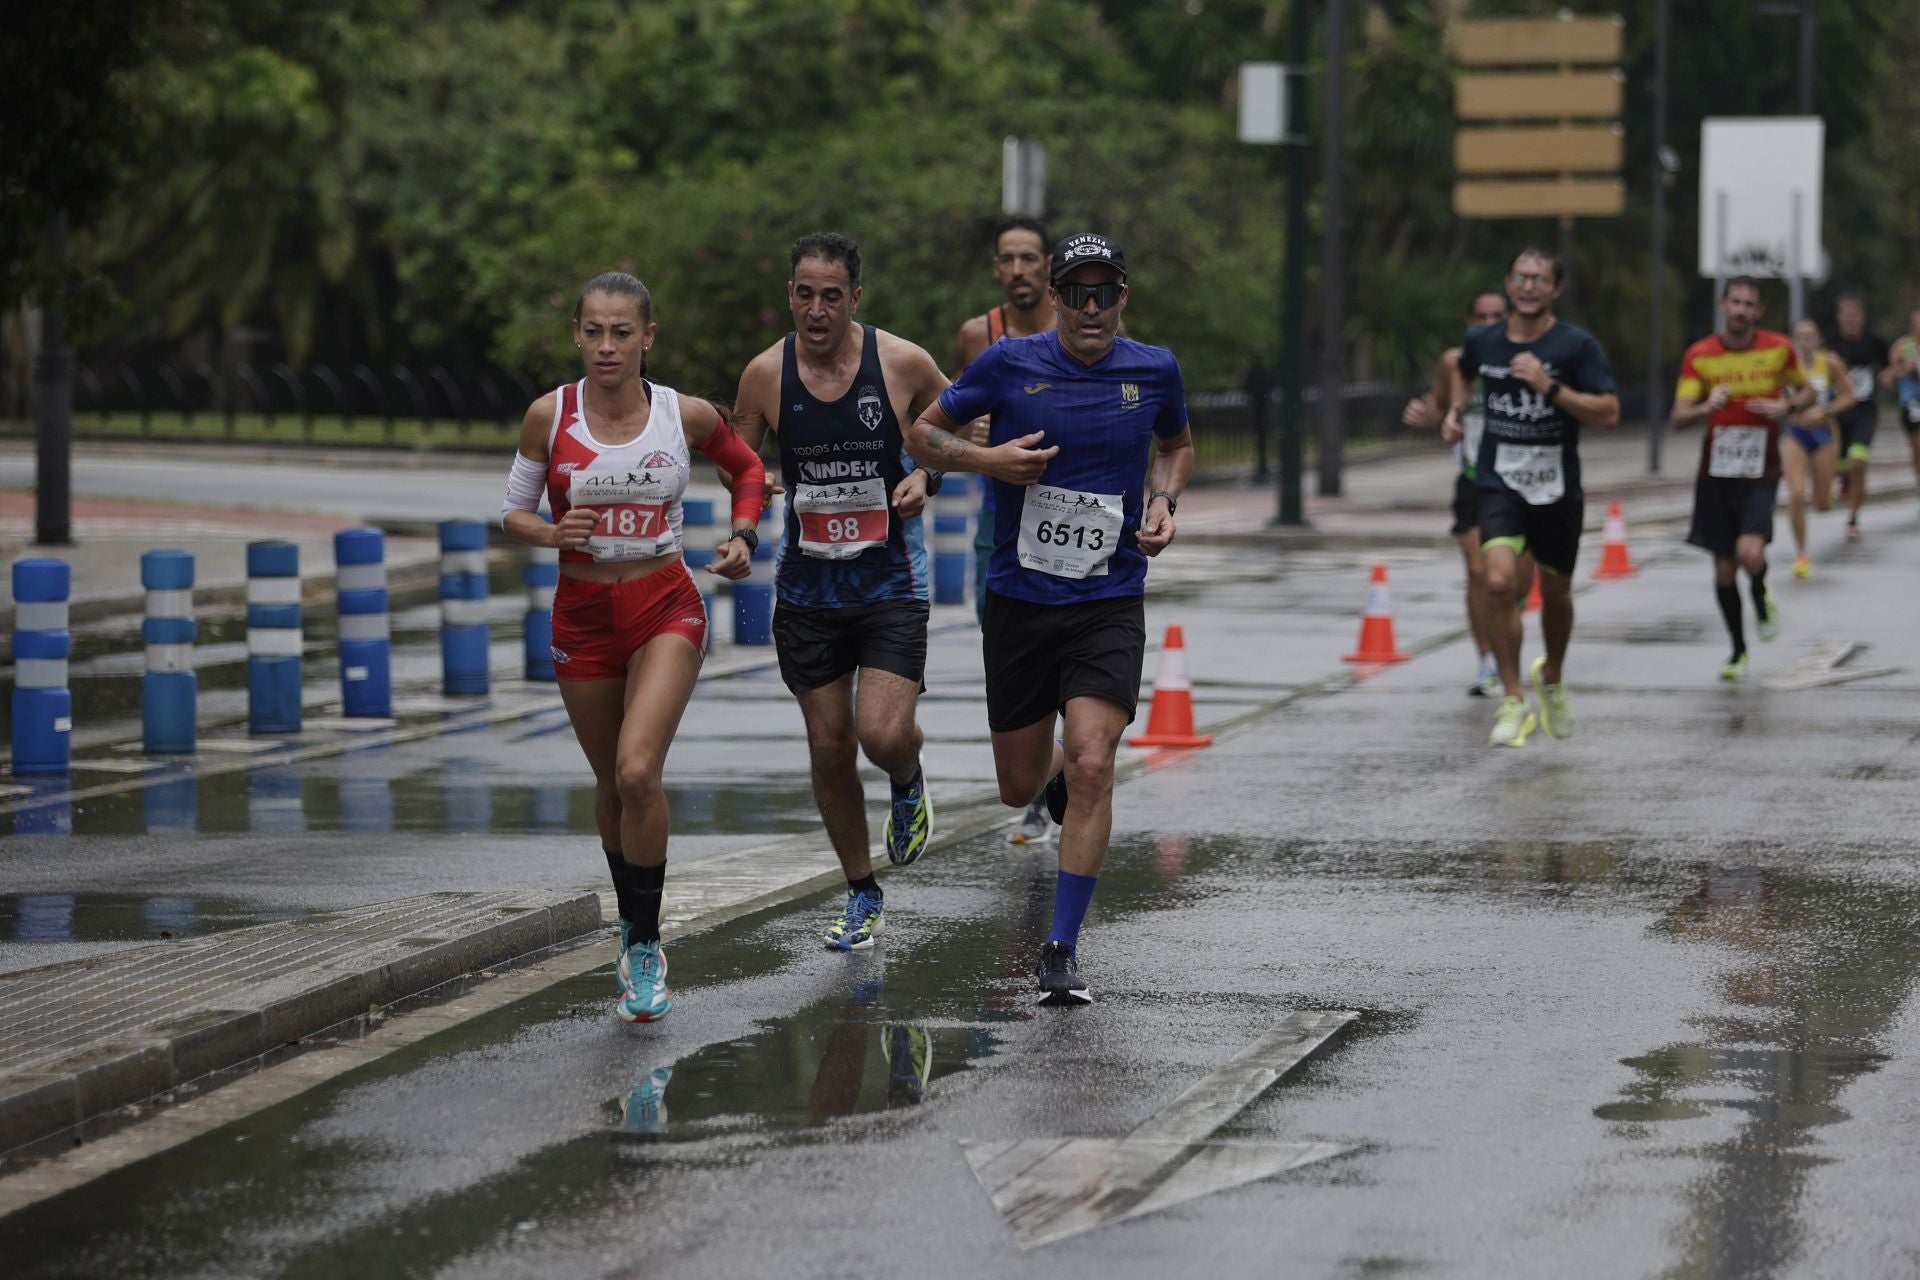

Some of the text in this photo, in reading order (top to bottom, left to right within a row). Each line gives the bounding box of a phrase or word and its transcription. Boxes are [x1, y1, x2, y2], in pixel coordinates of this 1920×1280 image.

[1068, 236, 1106, 247] VENEZIA
[792, 440, 885, 456] TOD@S A CORRER
[601, 507, 655, 535] 187
[827, 517, 860, 542] 98
[1036, 520, 1105, 551] 6513
